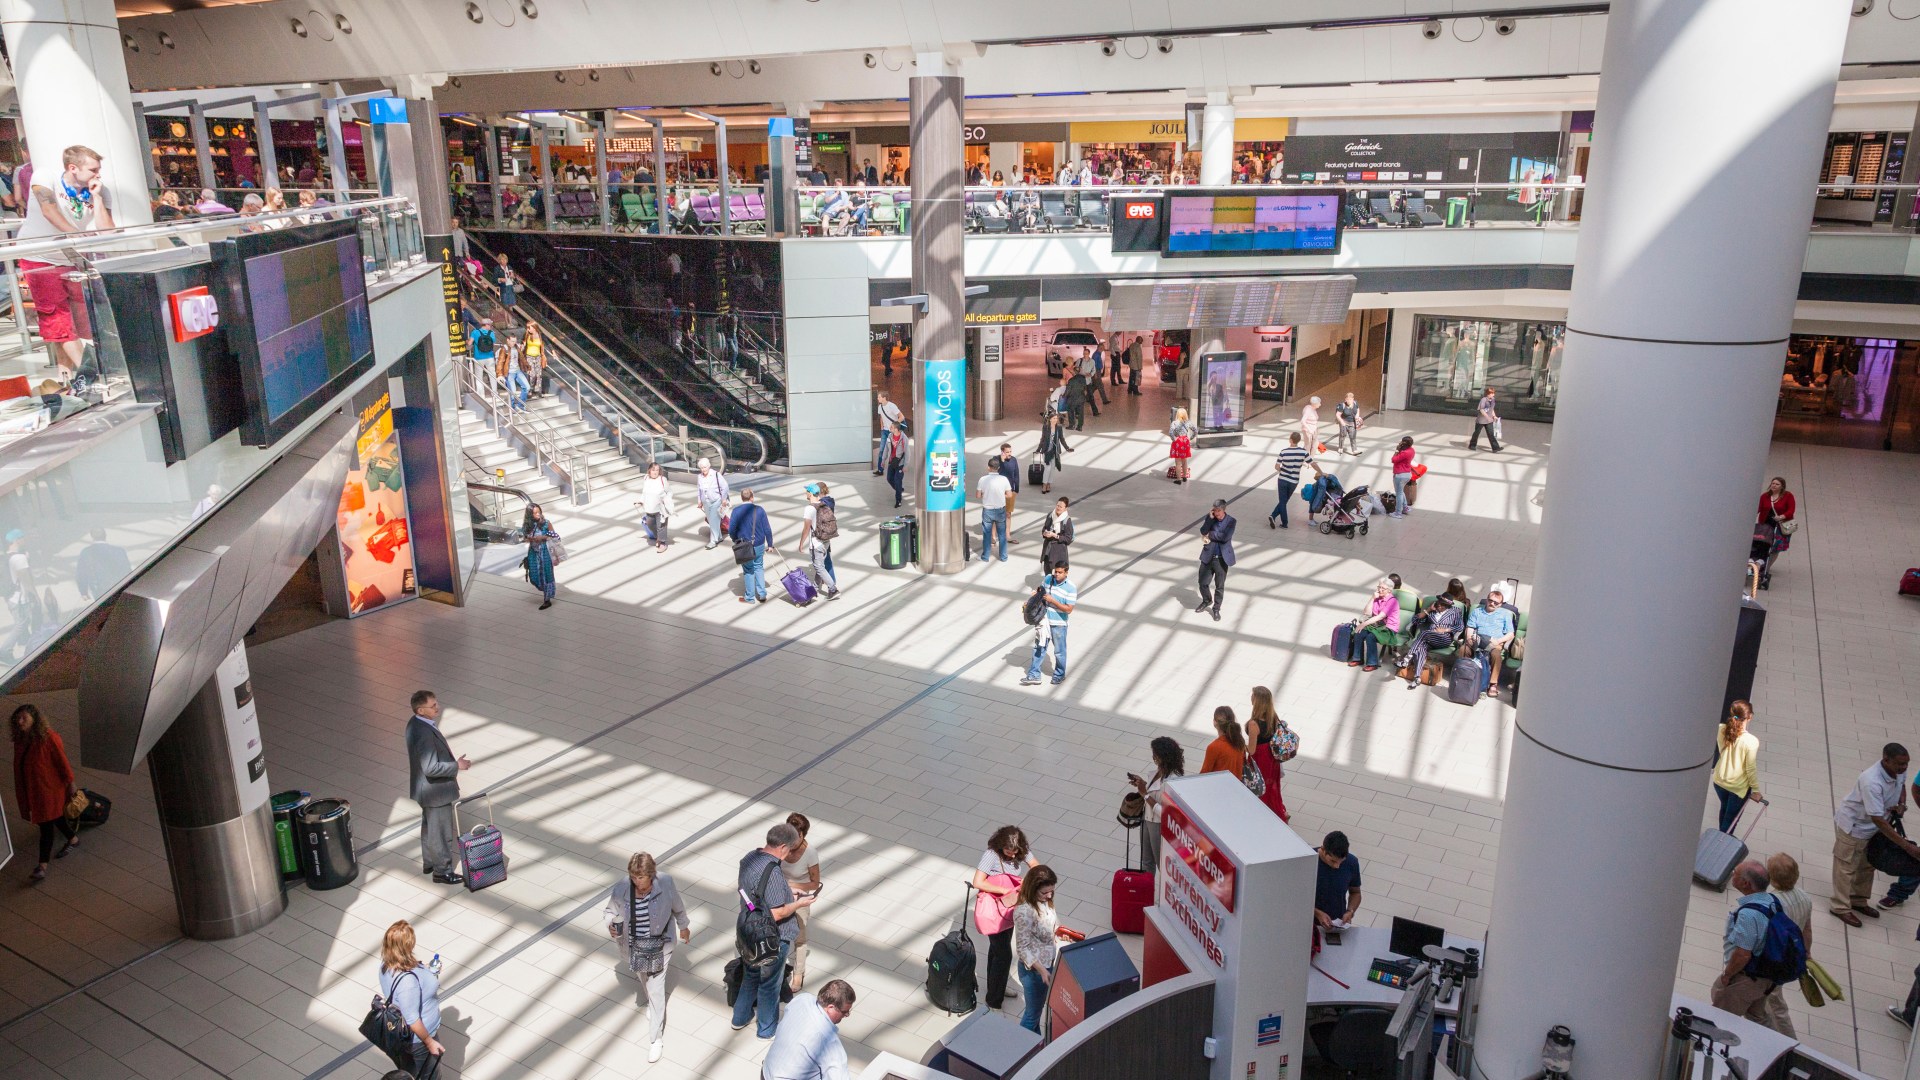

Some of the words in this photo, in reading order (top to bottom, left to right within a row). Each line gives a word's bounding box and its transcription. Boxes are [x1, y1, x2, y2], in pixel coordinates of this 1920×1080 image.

[1150, 123, 1187, 135] JOUL
[582, 138, 596, 152] TH
[1344, 142, 1382, 152] Gatwick
[1129, 205, 1153, 216] eye
[965, 314, 975, 322] All
[977, 314, 1014, 323] departure
[1016, 313, 1037, 323] gates
[934, 370, 955, 425] Maps
[255, 755, 265, 772] BOS
[1167, 814, 1224, 885] MONEYCORP
[1165, 855, 1221, 932] Currency
[1165, 881, 1224, 968] Exchange
